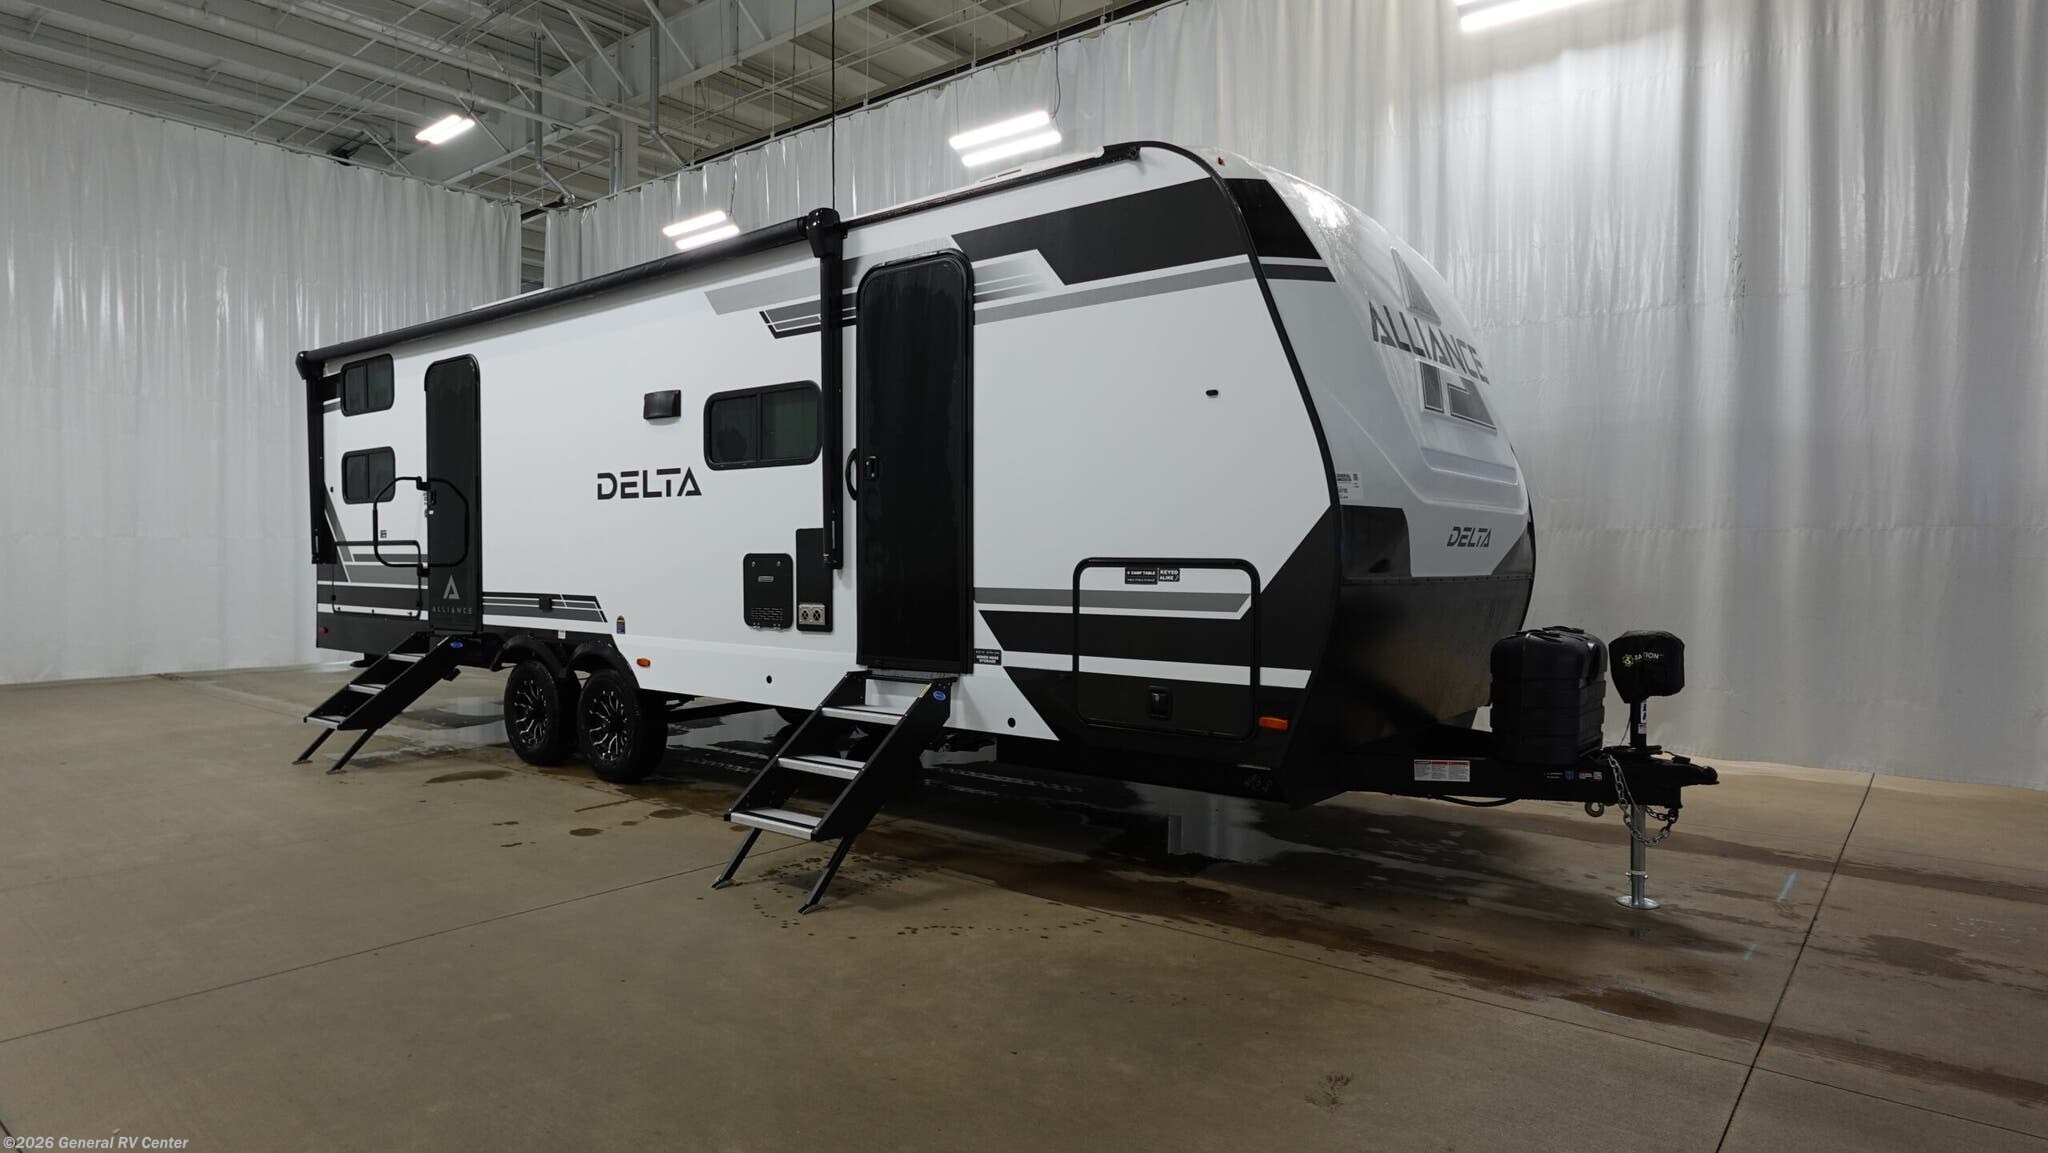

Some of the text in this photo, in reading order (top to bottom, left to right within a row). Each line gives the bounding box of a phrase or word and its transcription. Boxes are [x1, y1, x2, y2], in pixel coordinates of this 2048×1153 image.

[1369, 301, 1490, 384] ALLIANCE
[597, 467, 702, 500] DELTA
[1446, 526, 1491, 547] DELTA
[432, 606, 473, 615] ALLIANCE
